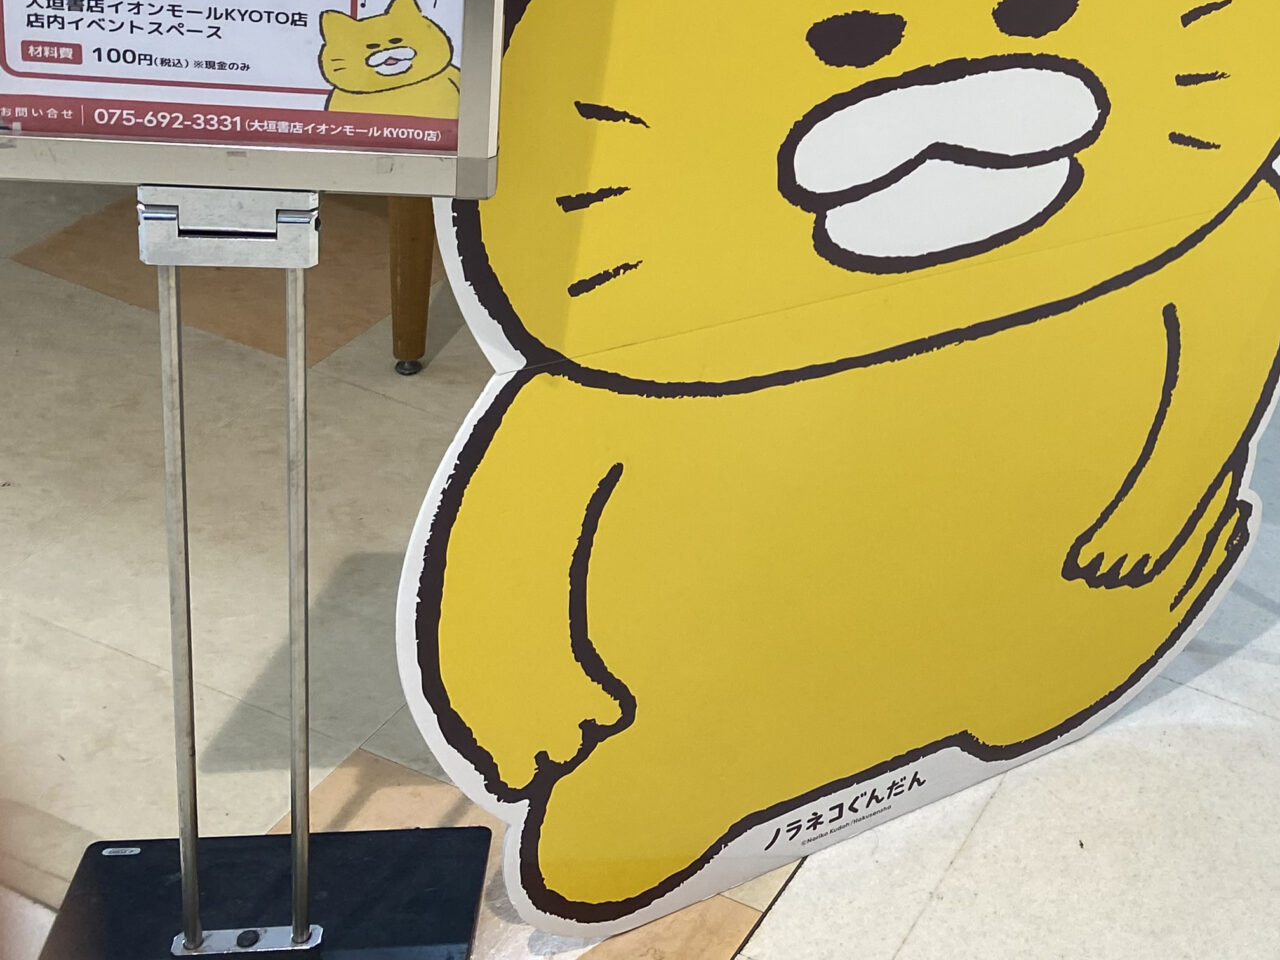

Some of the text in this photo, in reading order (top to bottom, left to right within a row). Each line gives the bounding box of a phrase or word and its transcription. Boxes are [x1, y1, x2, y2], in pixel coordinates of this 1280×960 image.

[26, 11, 223, 40] 店内イベントスペース
[27, 44, 74, 61] 材料費
[0, 106, 73, 119] お問い合せ
[94, 107, 242, 133] 075-692-3331
[764, 771, 927, 851] ノラネコぐんだん
